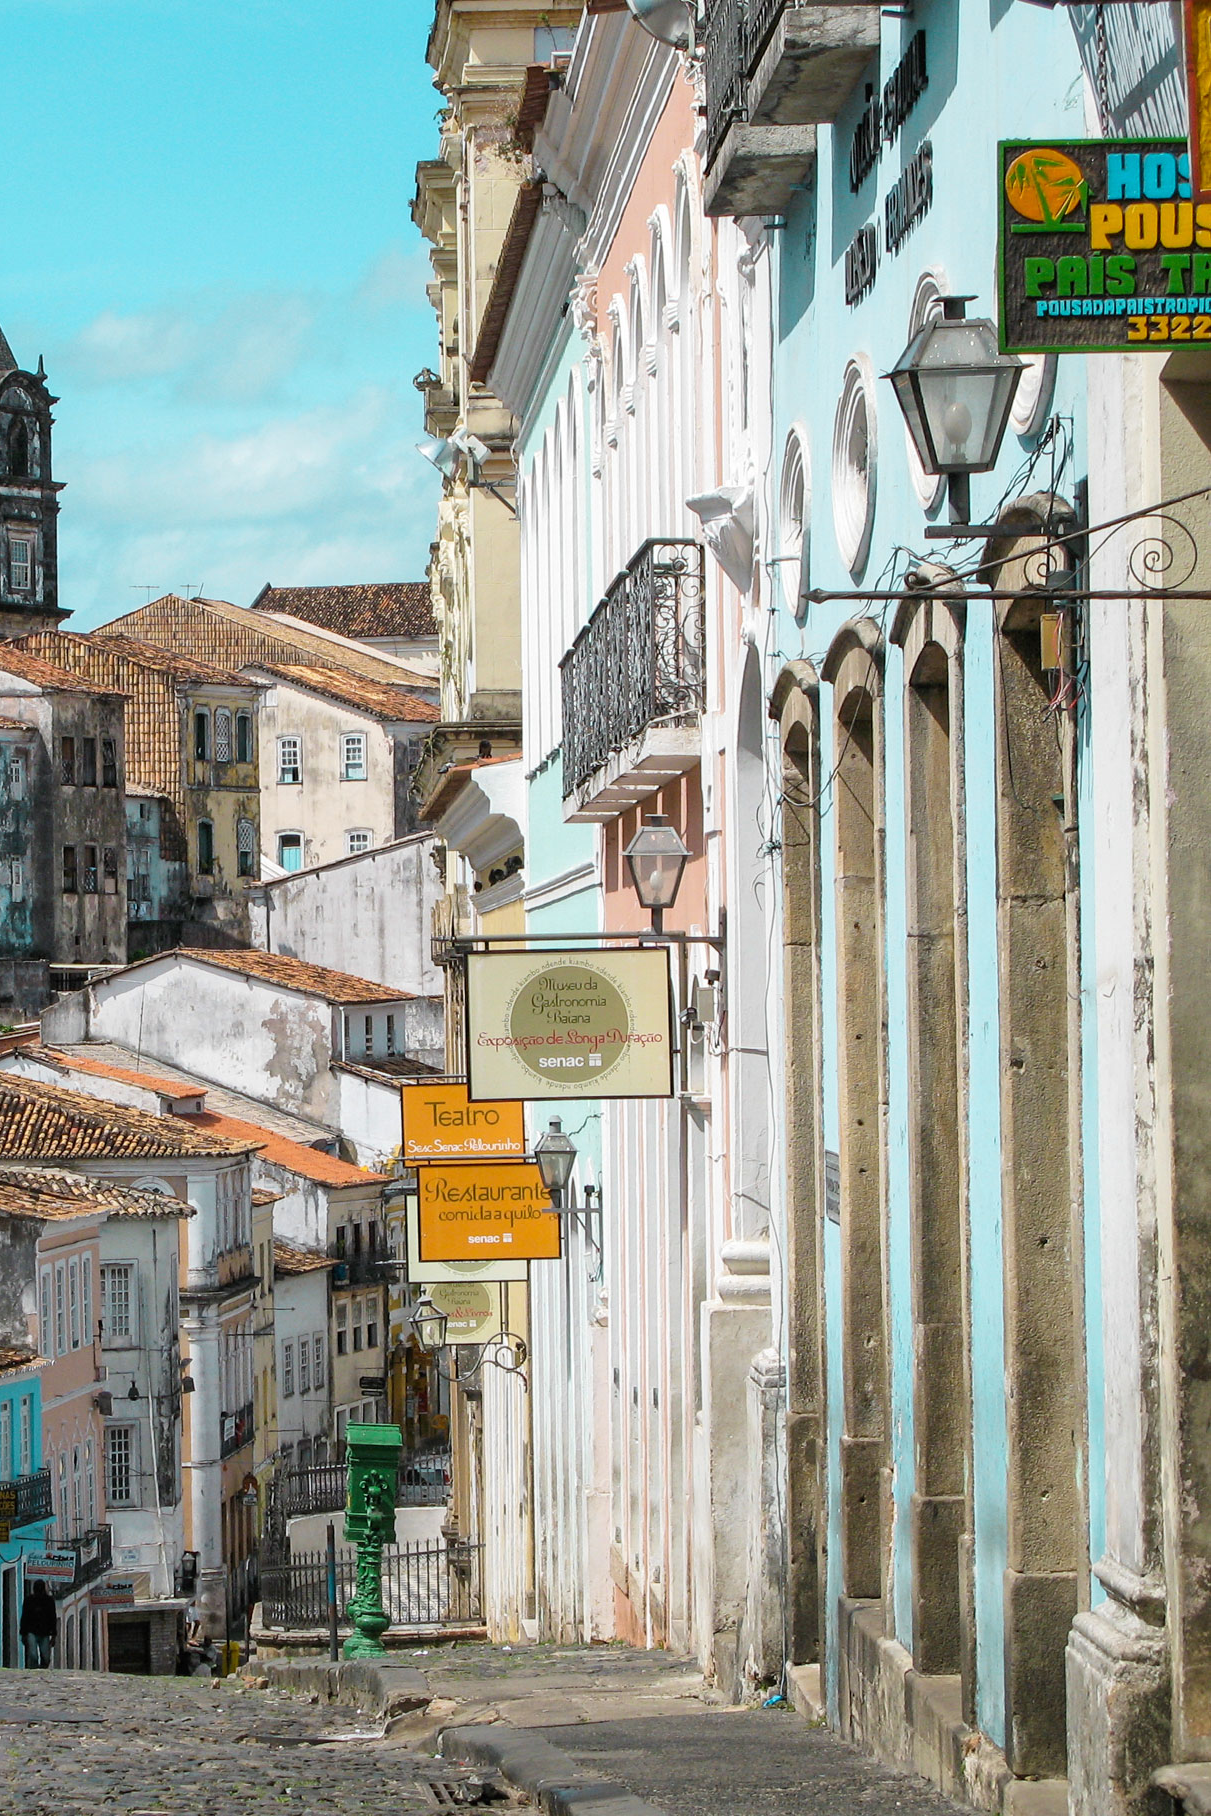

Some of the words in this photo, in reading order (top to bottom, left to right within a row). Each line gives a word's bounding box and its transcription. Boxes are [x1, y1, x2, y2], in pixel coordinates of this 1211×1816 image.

[1025, 251, 1137, 297] PAÍS
[1127, 316, 1211, 341] 3322
[538, 976, 582, 991] Museu
[584, 976, 598, 991] da
[531, 993, 607, 1015] Gastronomia
[546, 1010, 591, 1024] Baiana
[477, 1031, 545, 1052] Exposição
[546, 1029, 564, 1045] de
[564, 1029, 605, 1054] Longa
[606, 1028, 663, 1048] Duração
[538, 1056, 585, 1068] senac
[424, 1101, 500, 1127] Teatro
[407, 1139, 433, 1153] Sesc
[433, 1138, 463, 1152] Senac
[463, 1137, 521, 1151] Pelourinho
[425, 1177, 551, 1203] Restaurante
[438, 1205, 492, 1222] comida
[493, 1211, 502, 1220] a
[504, 1204, 541, 1228] quilo
[468, 1234, 501, 1244] senac
